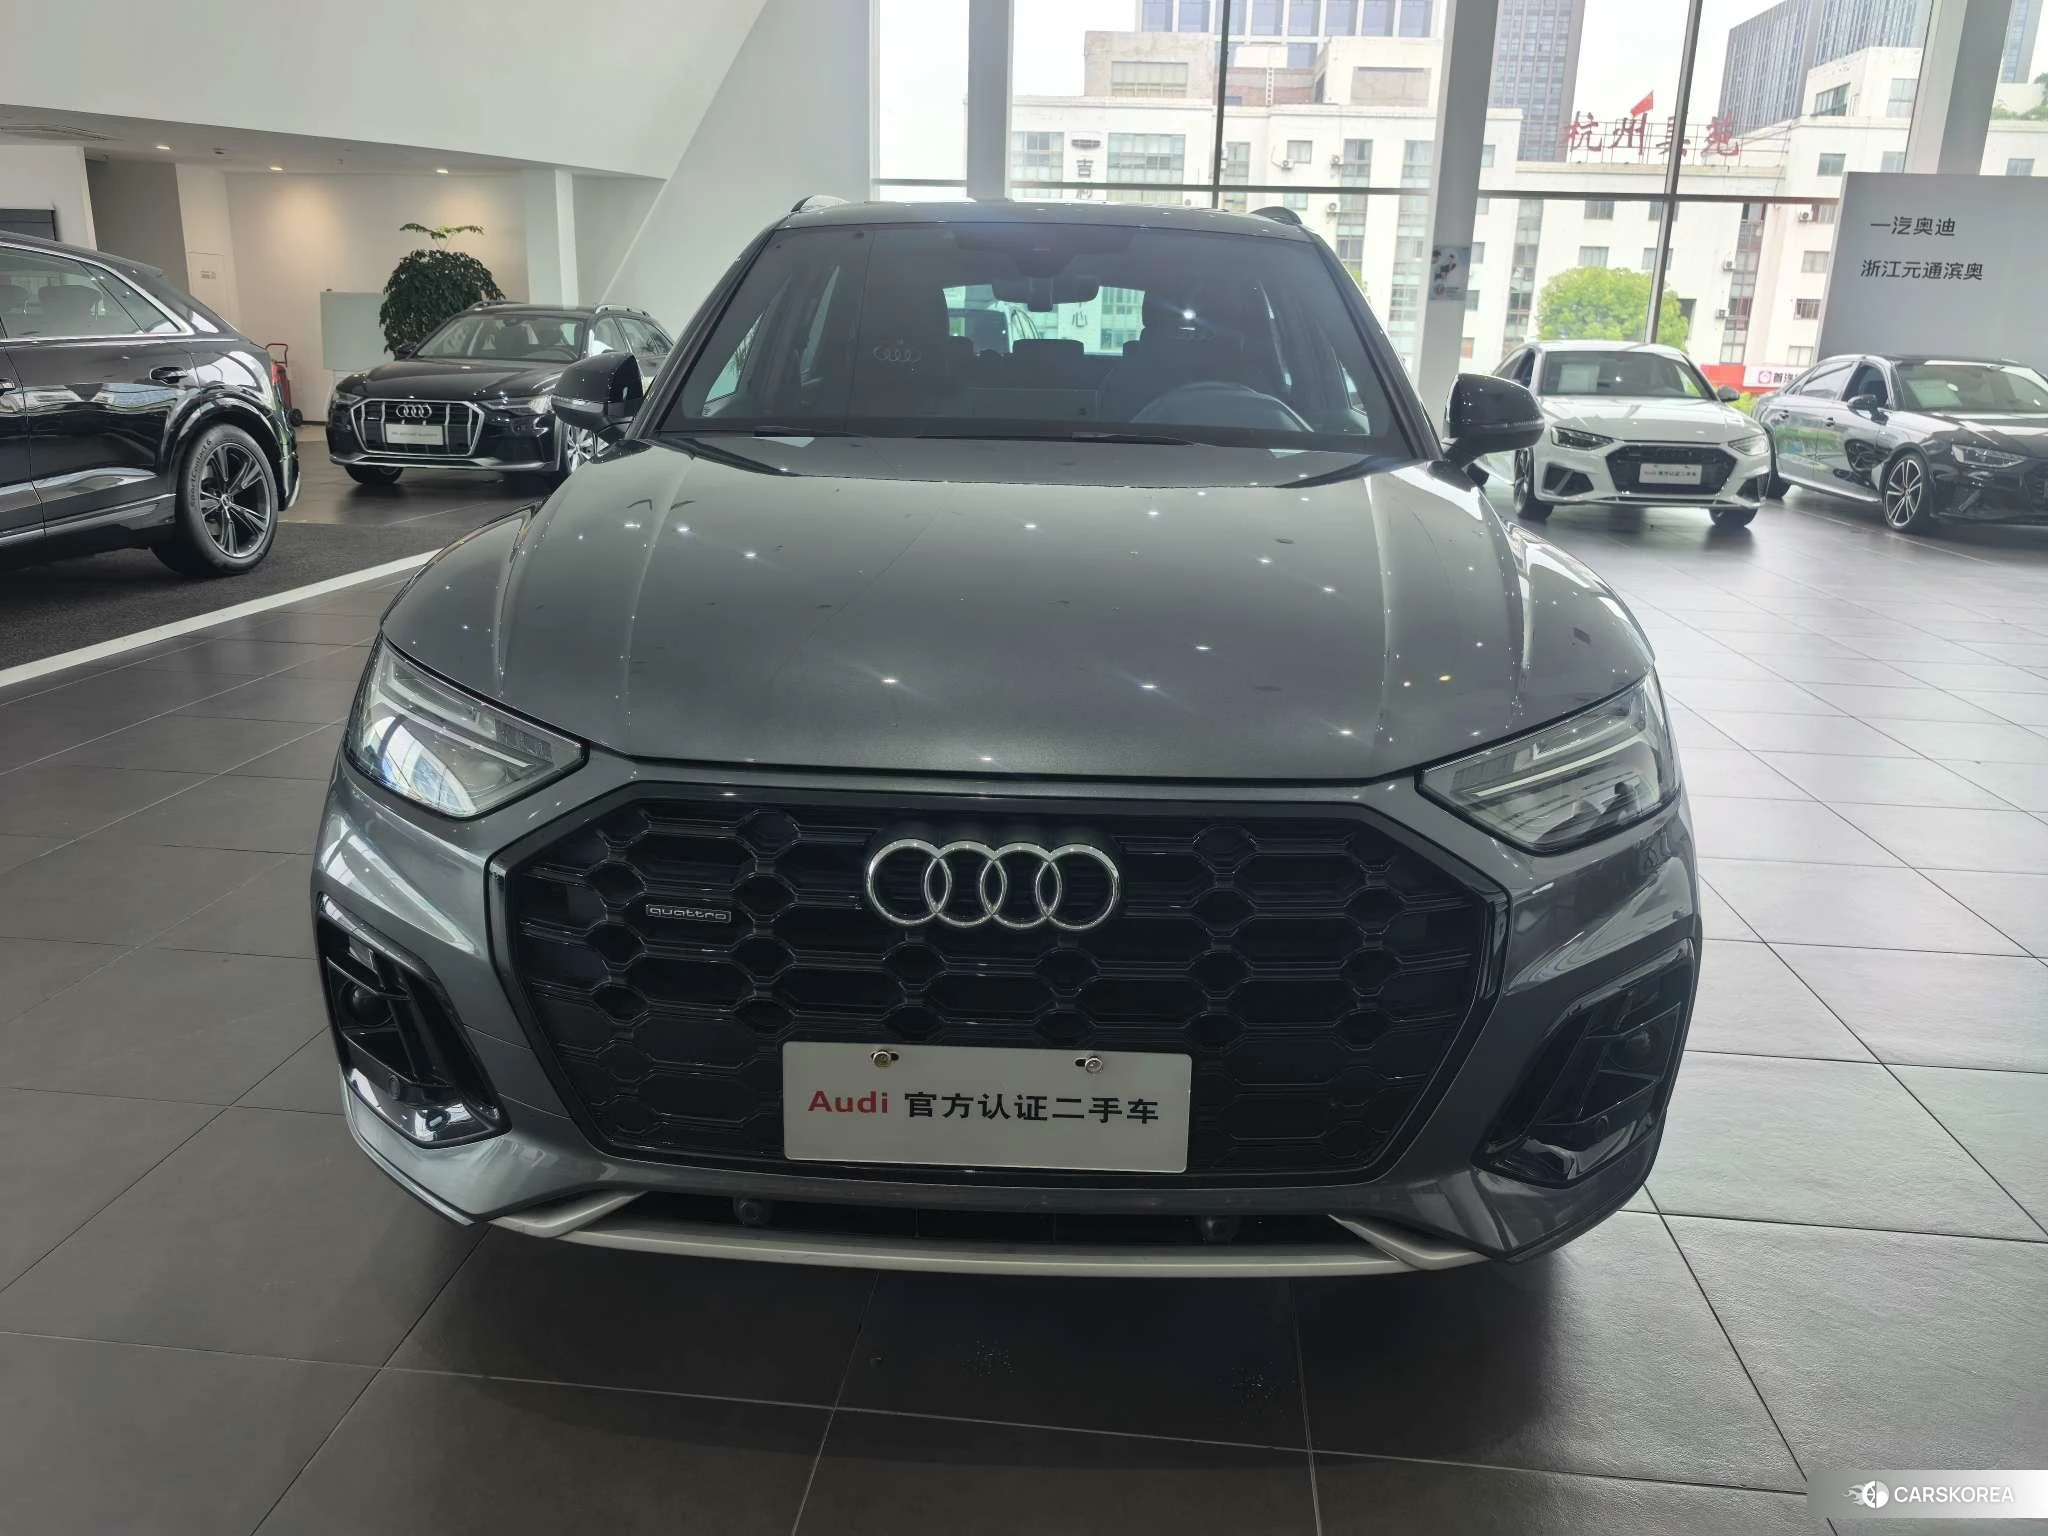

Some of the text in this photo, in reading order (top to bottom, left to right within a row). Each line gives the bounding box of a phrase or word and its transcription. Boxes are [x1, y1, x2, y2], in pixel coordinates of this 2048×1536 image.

[1870, 216, 1956, 237] 一汽奥迪
[1860, 259, 1983, 281] 浙江元通滨奥
[648, 906, 728, 920] quattro
[807, 1090, 1160, 1125] Audi 官方认证二手车
